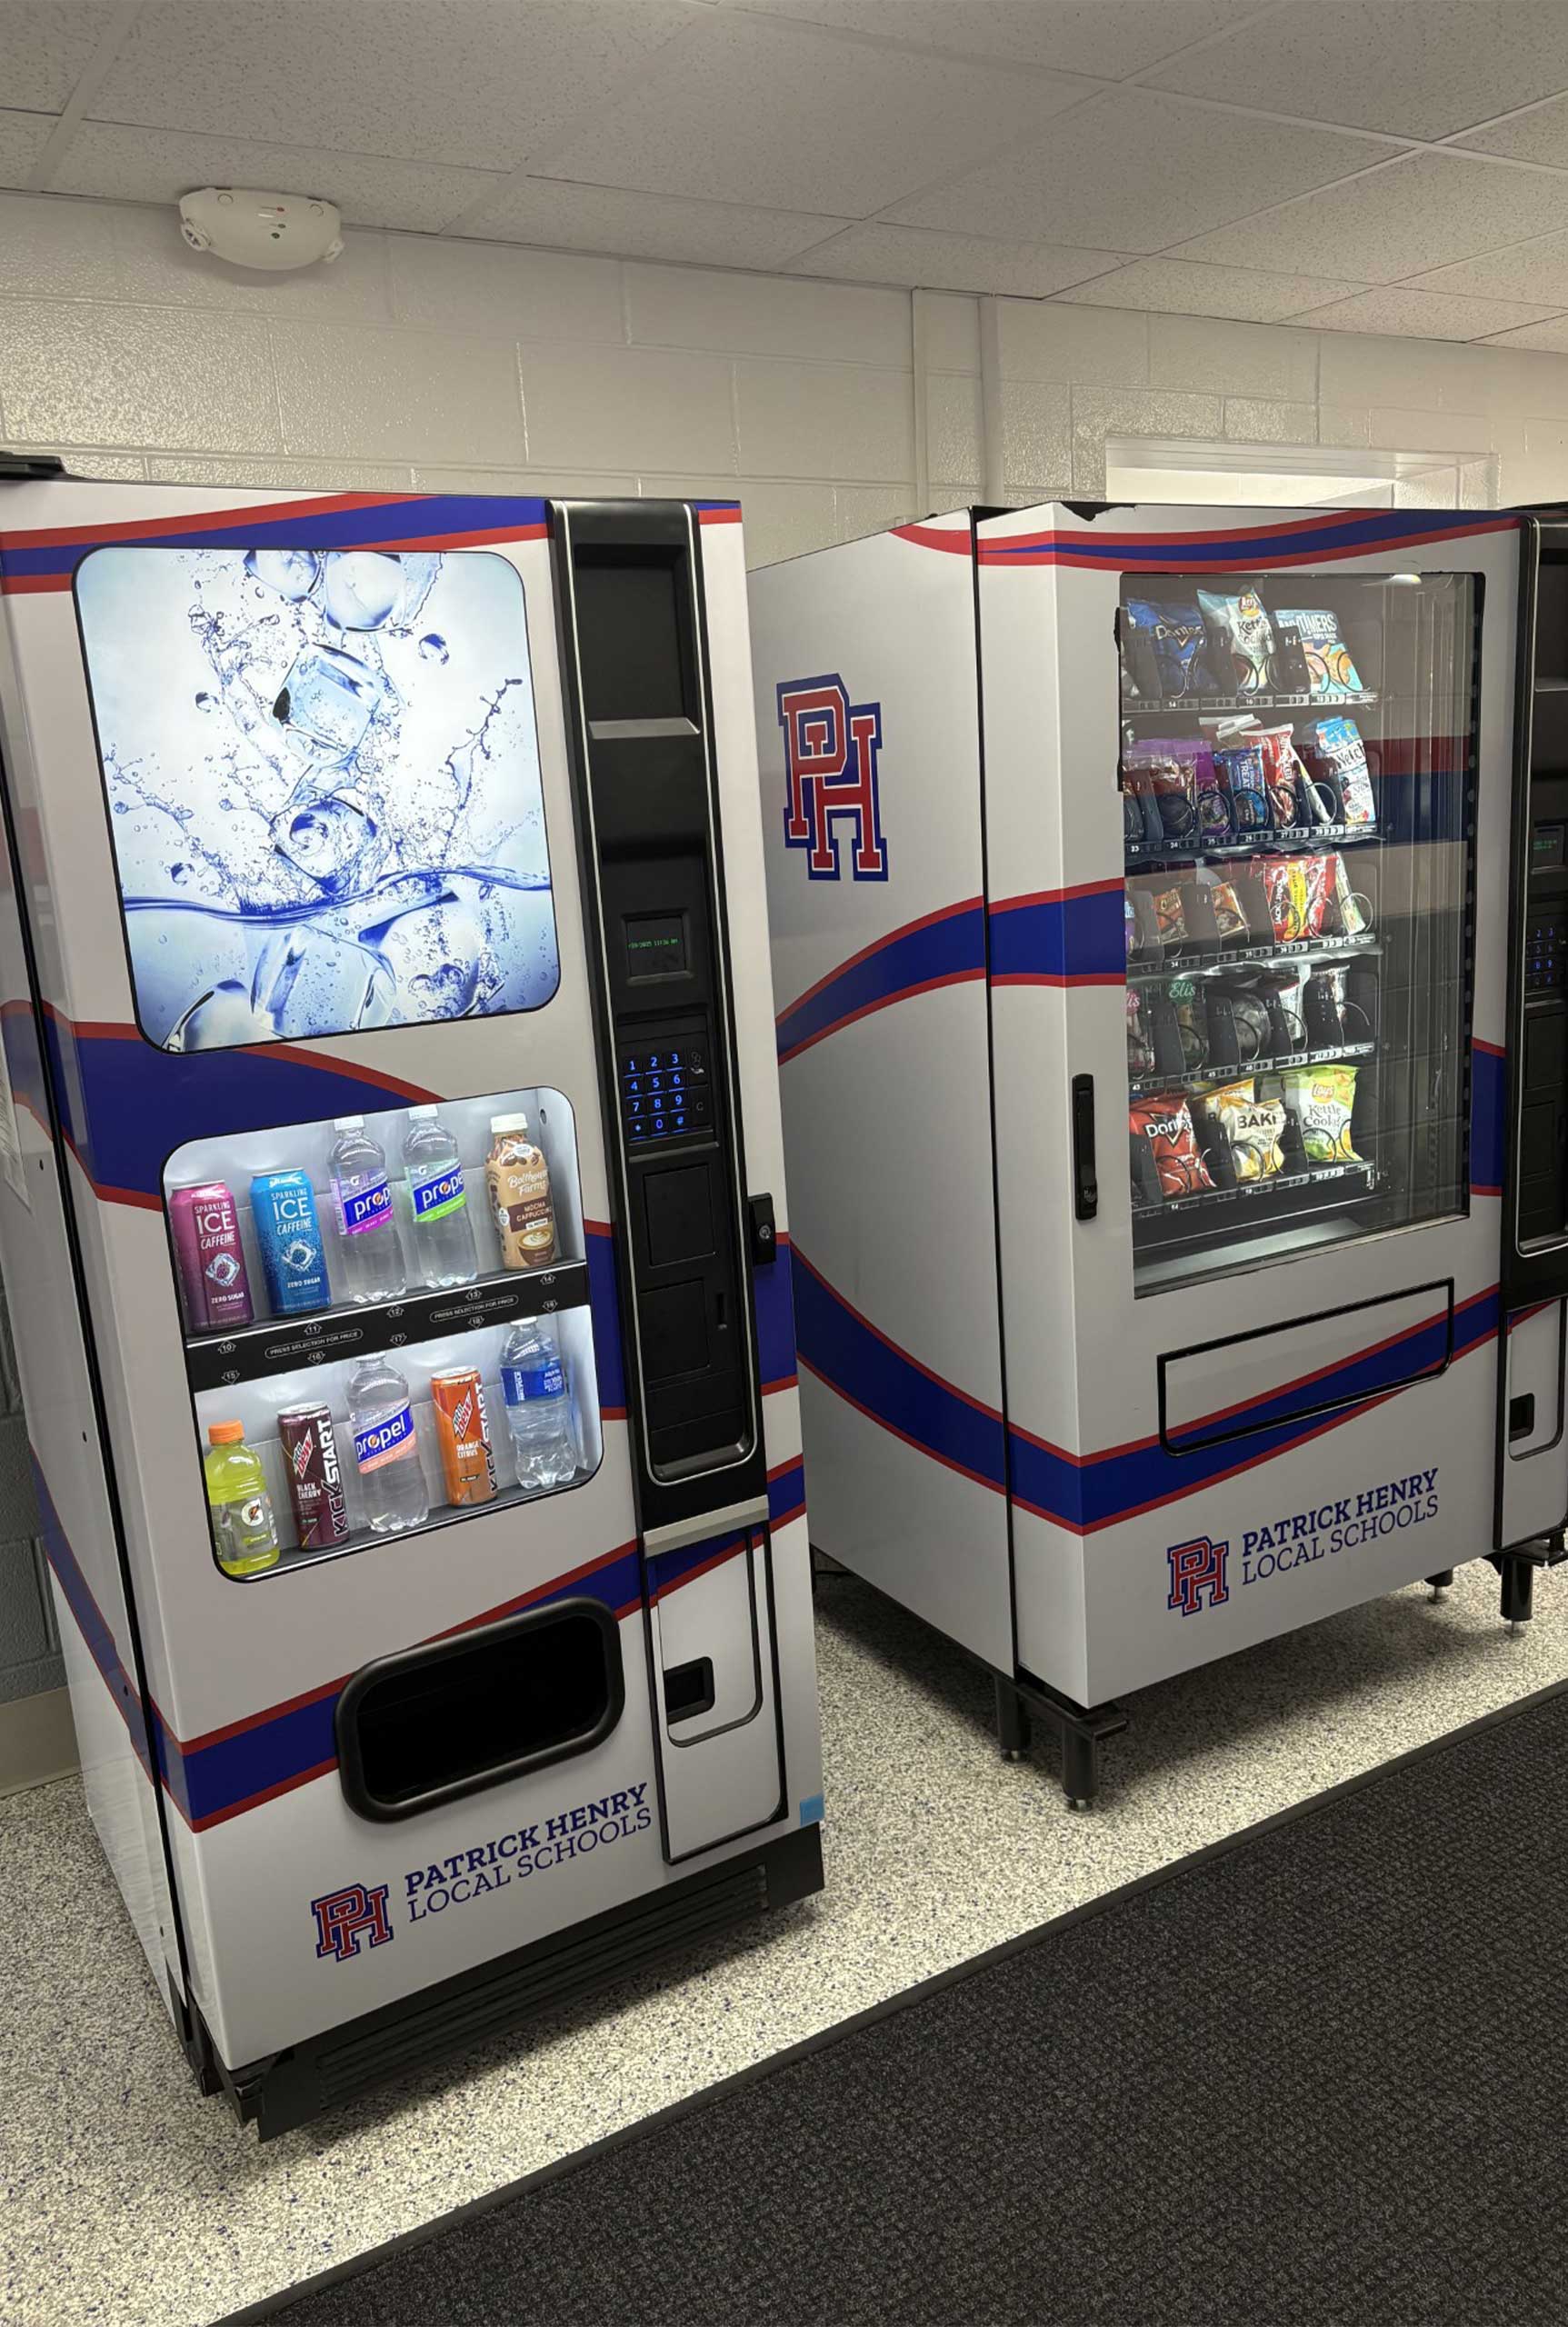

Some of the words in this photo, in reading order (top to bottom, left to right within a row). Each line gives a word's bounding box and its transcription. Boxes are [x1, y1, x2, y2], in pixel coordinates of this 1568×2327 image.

[629, 1061, 635, 1071] 1
[650, 1056, 658, 1067] 2
[672, 1054, 679, 1064] 3
[630, 1081, 638, 1091] 4
[653, 1077, 660, 1088] 5
[674, 1074, 681, 1084] 6
[633, 1102, 640, 1112] 7
[654, 1098, 662, 1109] 8
[675, 1094, 683, 1105] 9
[1307, 1104, 1341, 1118] Kettle
[655, 1119, 664, 1129] 0
[1303, 1115, 1340, 1128] Cook
[270, 1187, 307, 1201] SPARKLING
[422, 1172, 464, 1209] prope
[194, 1200, 231, 1214] SPARKLING
[273, 1197, 313, 1221] ICE
[354, 1187, 391, 1221] prop
[195, 1211, 235, 1235] ICE
[276, 1217, 313, 1236] CAFFEINE
[200, 1231, 235, 1250] CAFFEINE
[210, 1294, 227, 1304] ZERO
[291, 1337, 325, 1352] SELECTION
[326, 1334, 339, 1343] FOR
[340, 1331, 358, 1341] PRICE
[355, 1414, 405, 1461] propel
[317, 1419, 349, 1537] KICKSTART
[241, 1498, 265, 1527] G
[1242, 1498, 1352, 1557] PATRICK
[1356, 1467, 1439, 1517] HENRY
[1242, 1536, 1325, 1585] LOCAL
[1330, 1494, 1439, 1553] SCHOOLS
[1167, 1535, 1230, 1617] PH
[404, 1824, 541, 1897] PATRICK
[545, 1783, 648, 1842] HENRY
[407, 1865, 512, 1923] LOCAL
[516, 1807, 652, 1879] SCHOOLS
[310, 1883, 394, 1962] PH
